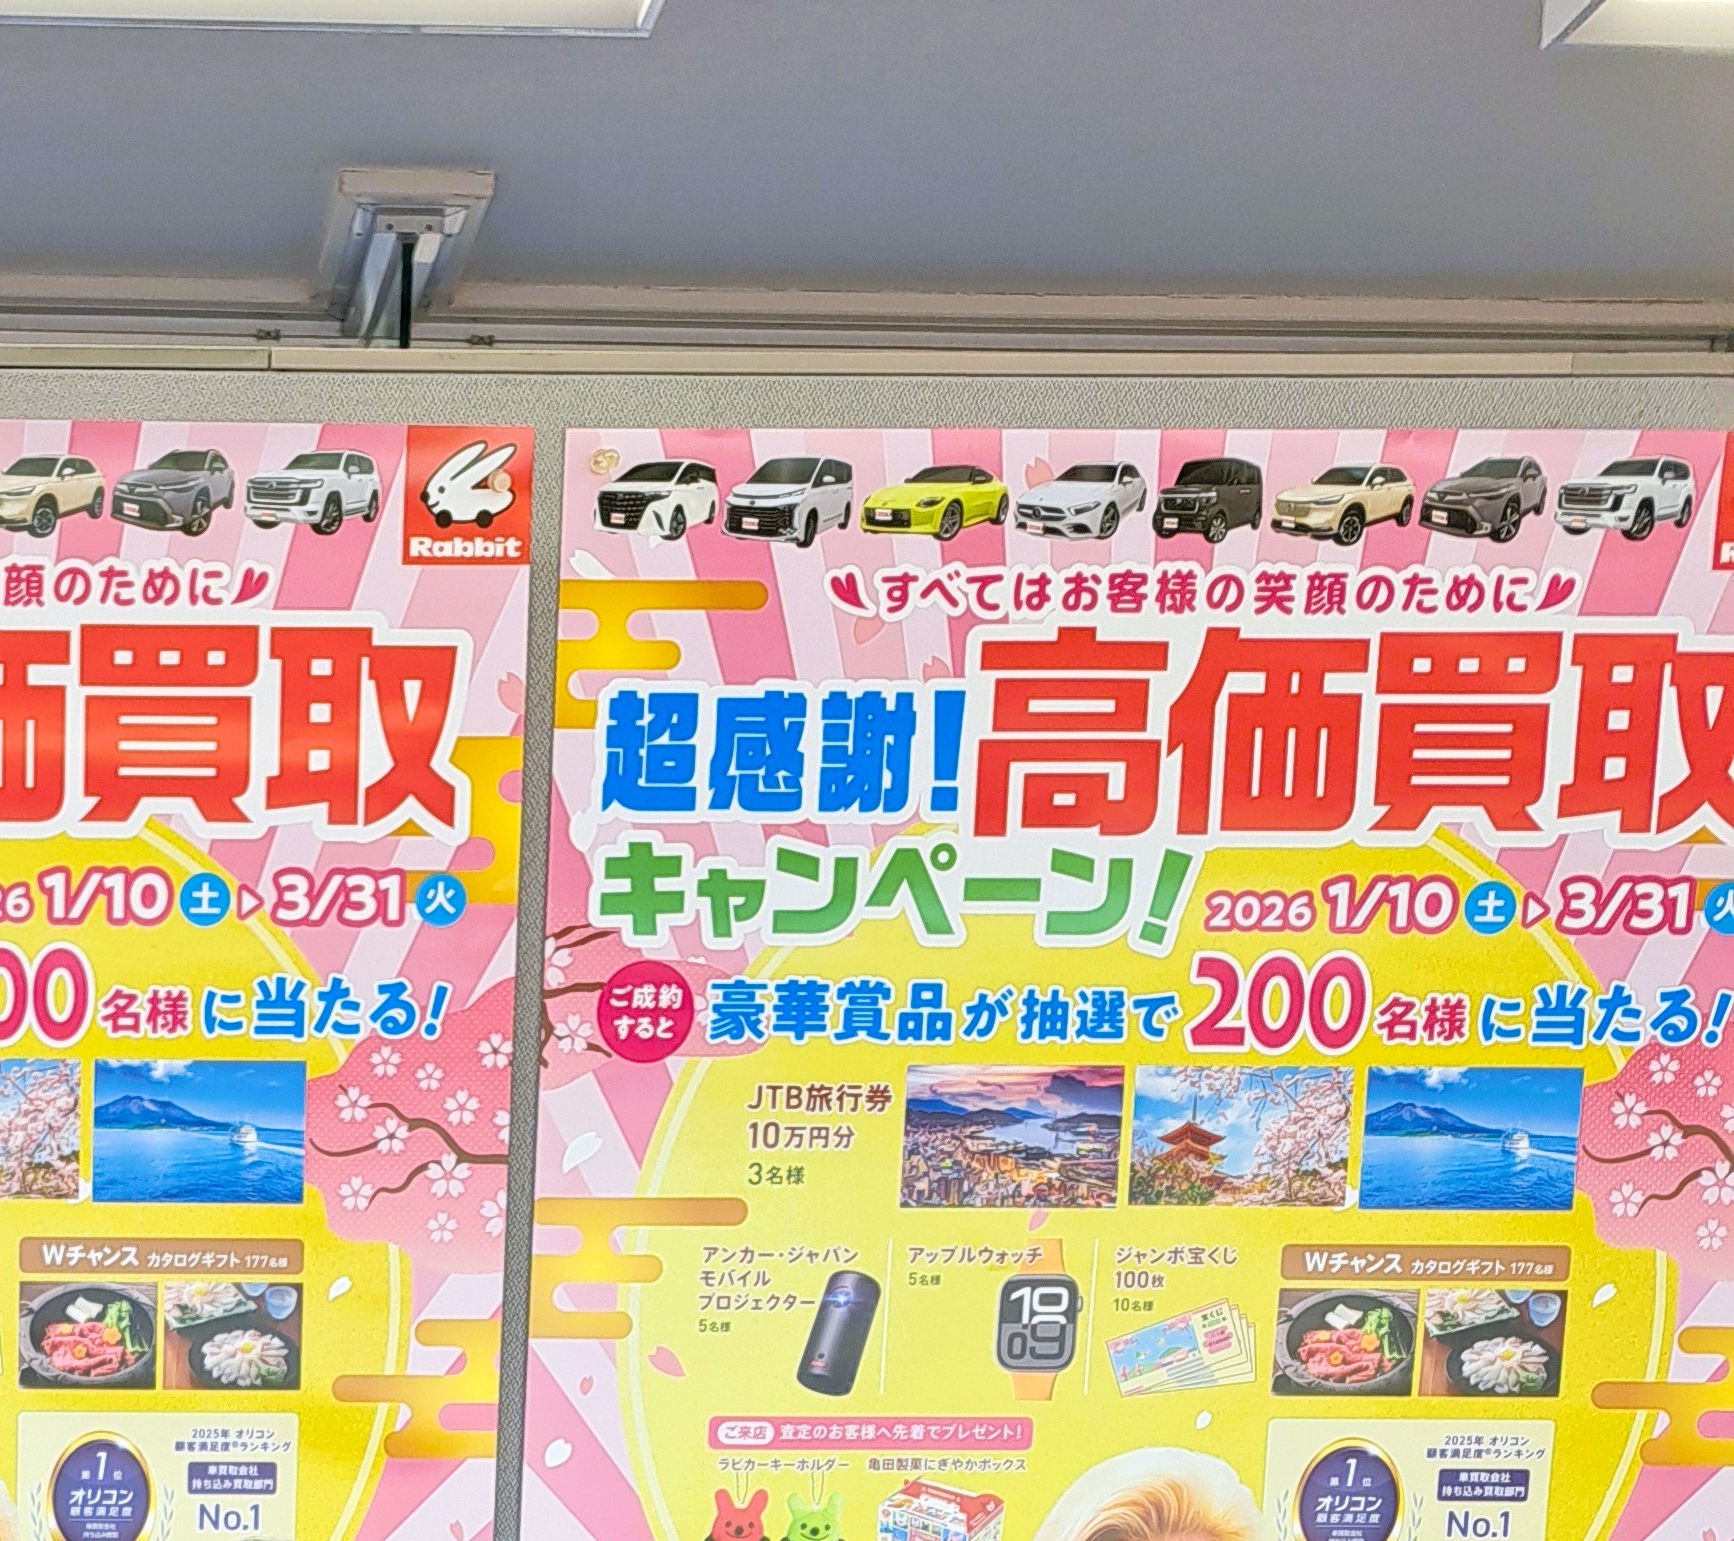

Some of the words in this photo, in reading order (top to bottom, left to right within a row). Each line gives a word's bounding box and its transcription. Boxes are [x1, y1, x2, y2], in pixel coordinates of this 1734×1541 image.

[409, 536, 522, 560] Rabbit
[881, 570, 1530, 615] すべてはお客様の笑顔のために
[974, 627, 1734, 838] 高価買取
[425, 883, 459, 917] 火
[601, 842, 1191, 946] キャンペーン!
[1208, 896, 1313, 931] 2026
[1325, 881, 1454, 933] 1/10
[1473, 888, 1507, 925] 土
[1557, 881, 1690, 933] 3/31
[609, 985, 682, 1009] ご成約
[613, 1015, 675, 1040] すると
[747, 1084, 892, 1113] JTB旅行券
[748, 1122, 855, 1151] 10万円分
[748, 1163, 805, 1185] 3名様
[42, 1245, 139, 1268] Wチャンス
[147, 1250, 240, 1270] カタログギフト
[908, 1247, 1042, 1264] アップルウォッチ
[1116, 1246, 1238, 1266] ジャンボ宝くじ
[1304, 1252, 1402, 1273] Wチャンス
[1411, 1259, 1505, 1276] カタログギフト
[700, 1270, 771, 1287] モバイル
[908, 1272, 941, 1286] 5名様
[1114, 1271, 1165, 1289] 100枚
[698, 1294, 816, 1311] プロジェクター
[1113, 1298, 1154, 1312] 10名様
[723, 1425, 768, 1441] ご来店
[1444, 1435, 1485, 1446] 2025年
[69, 1488, 133, 1505] オリコン
[1315, 1496, 1382, 1513] オリコン
[199, 1504, 259, 1531] No.1
[1447, 1511, 1511, 1538] No.1
